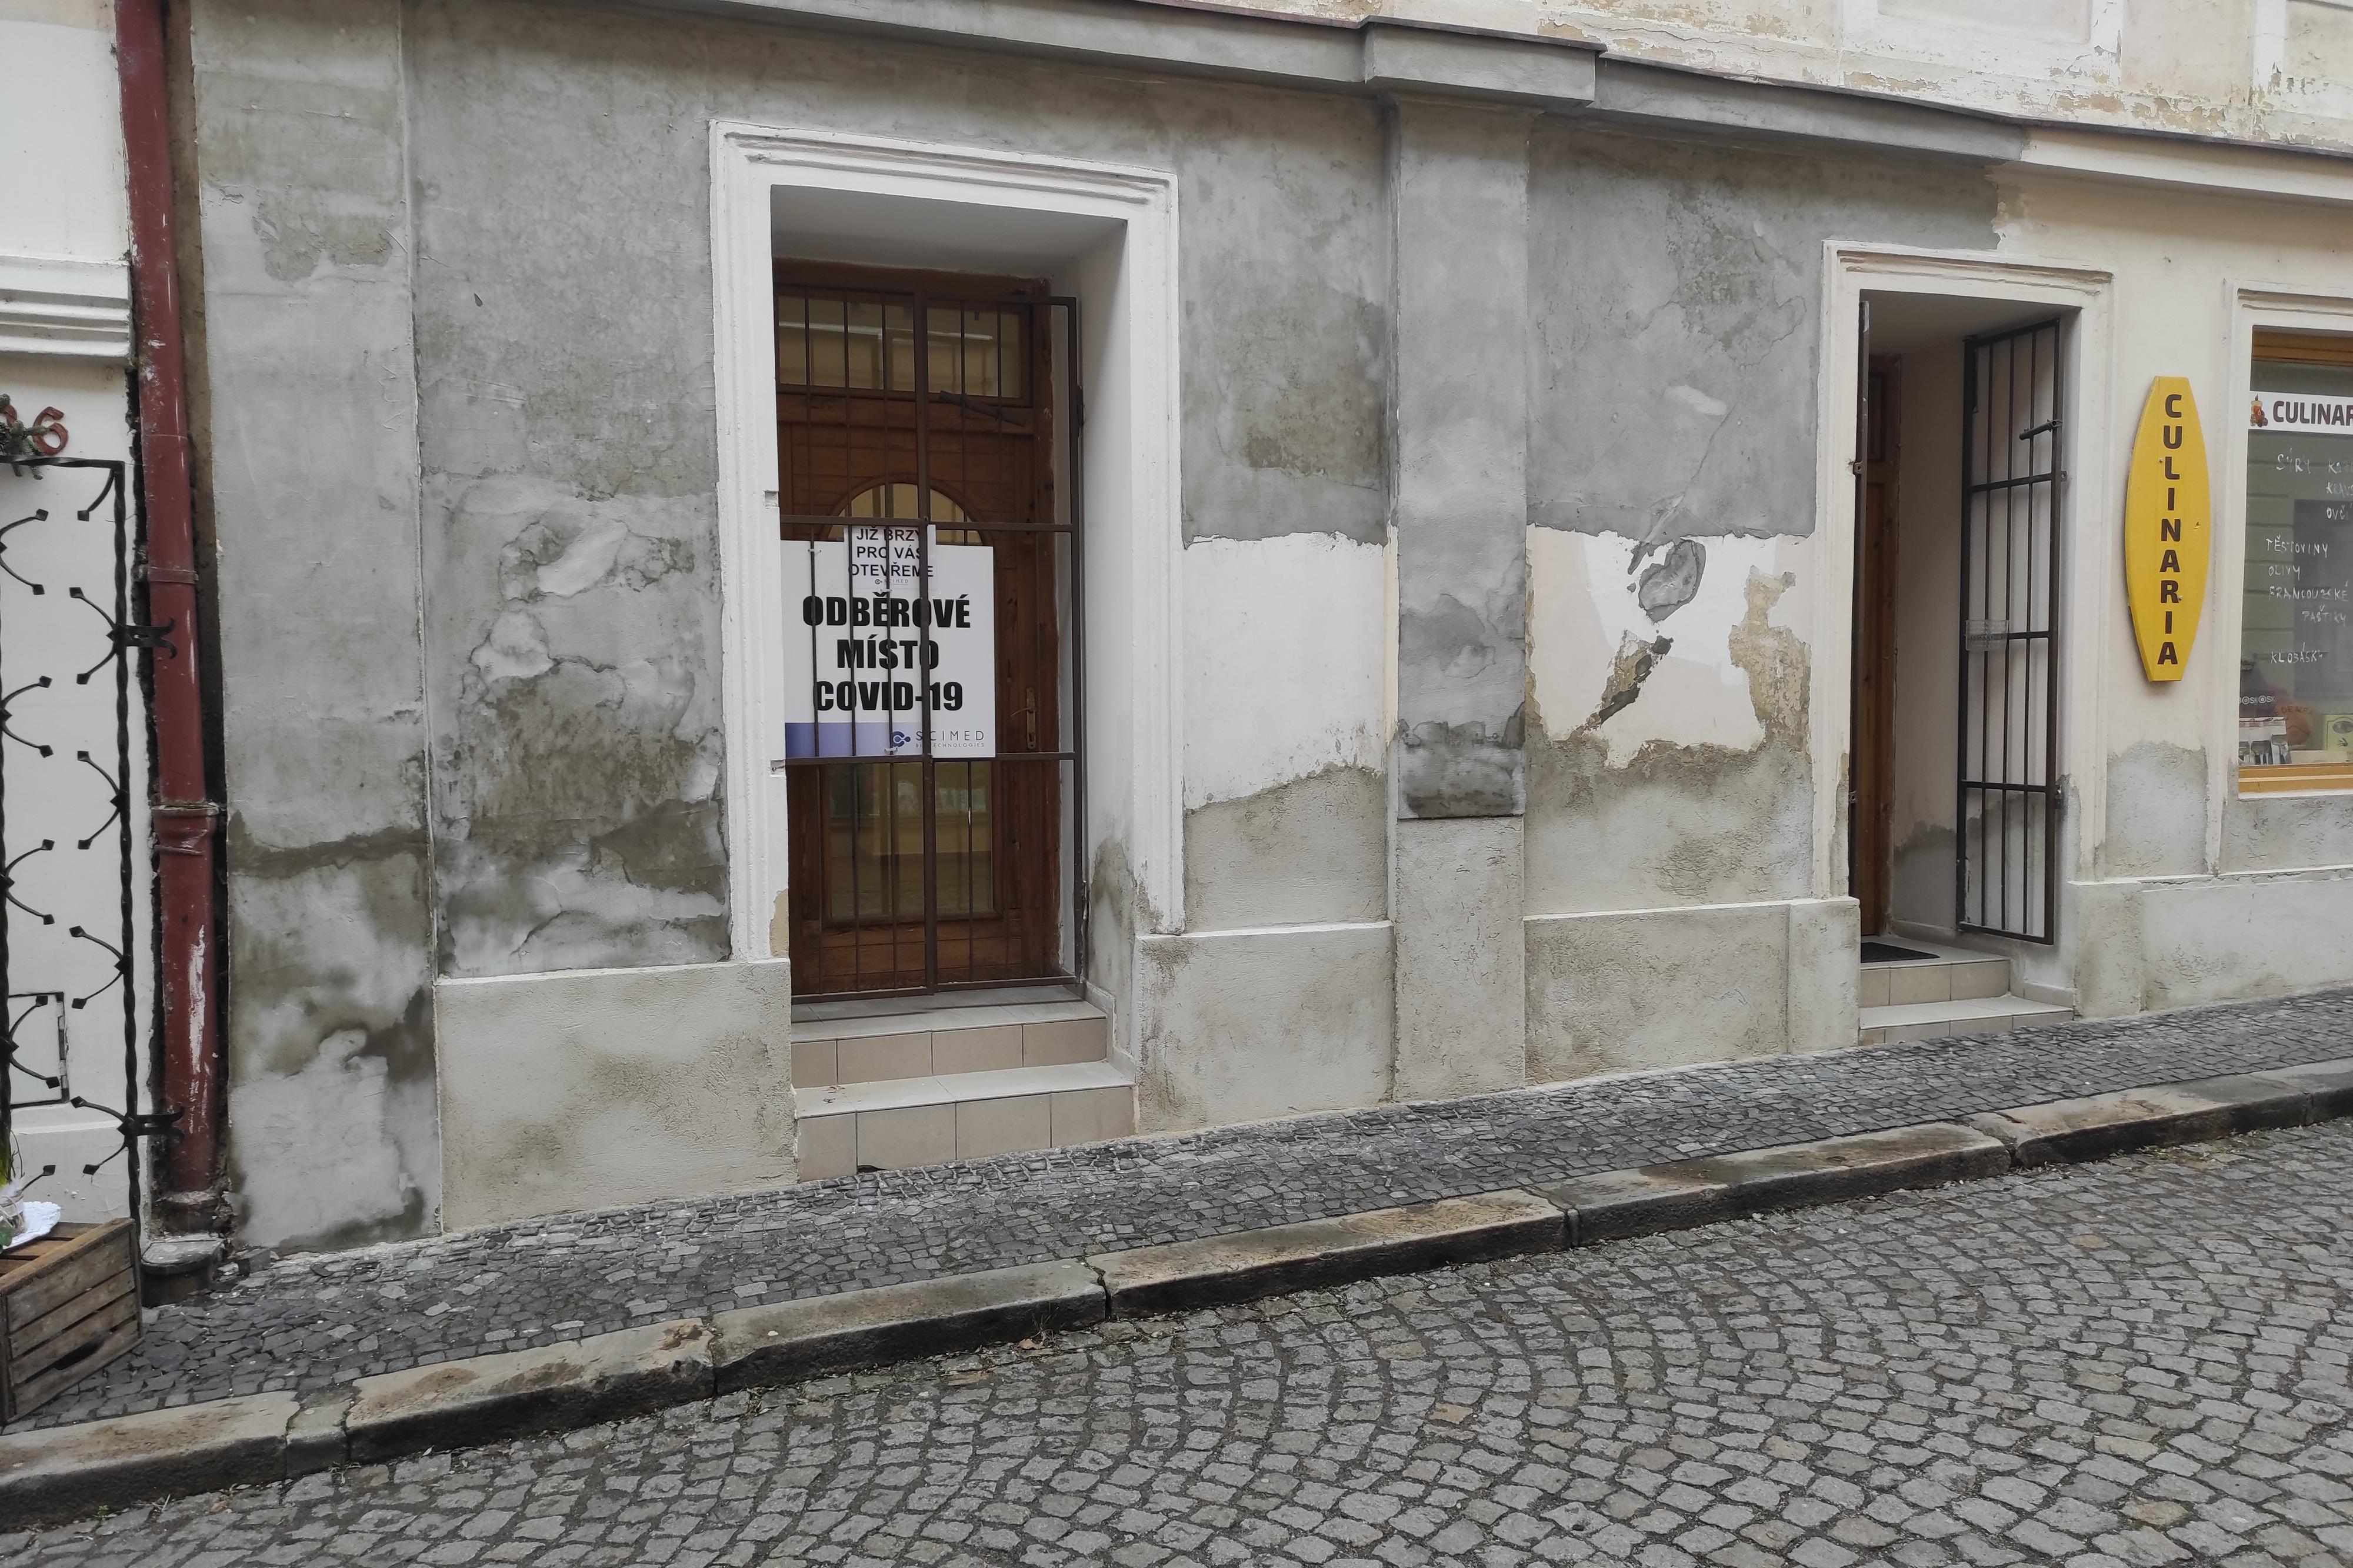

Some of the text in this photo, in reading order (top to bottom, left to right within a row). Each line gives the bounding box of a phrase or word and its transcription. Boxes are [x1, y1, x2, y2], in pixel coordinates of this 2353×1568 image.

[856, 525, 878, 540] JIŽ
[2157, 393, 2182, 665] CULINARIA
[856, 546, 888, 559] PRO
[2266, 535, 2328, 558] TĚSTOVINY
[2268, 565, 2300, 581] OLIVY
[803, 591, 971, 628] ODBĚROVÉ
[837, 634, 939, 669] MÍSTO
[814, 681, 963, 710] COVID-19
[916, 730, 984, 741] SCIMED
